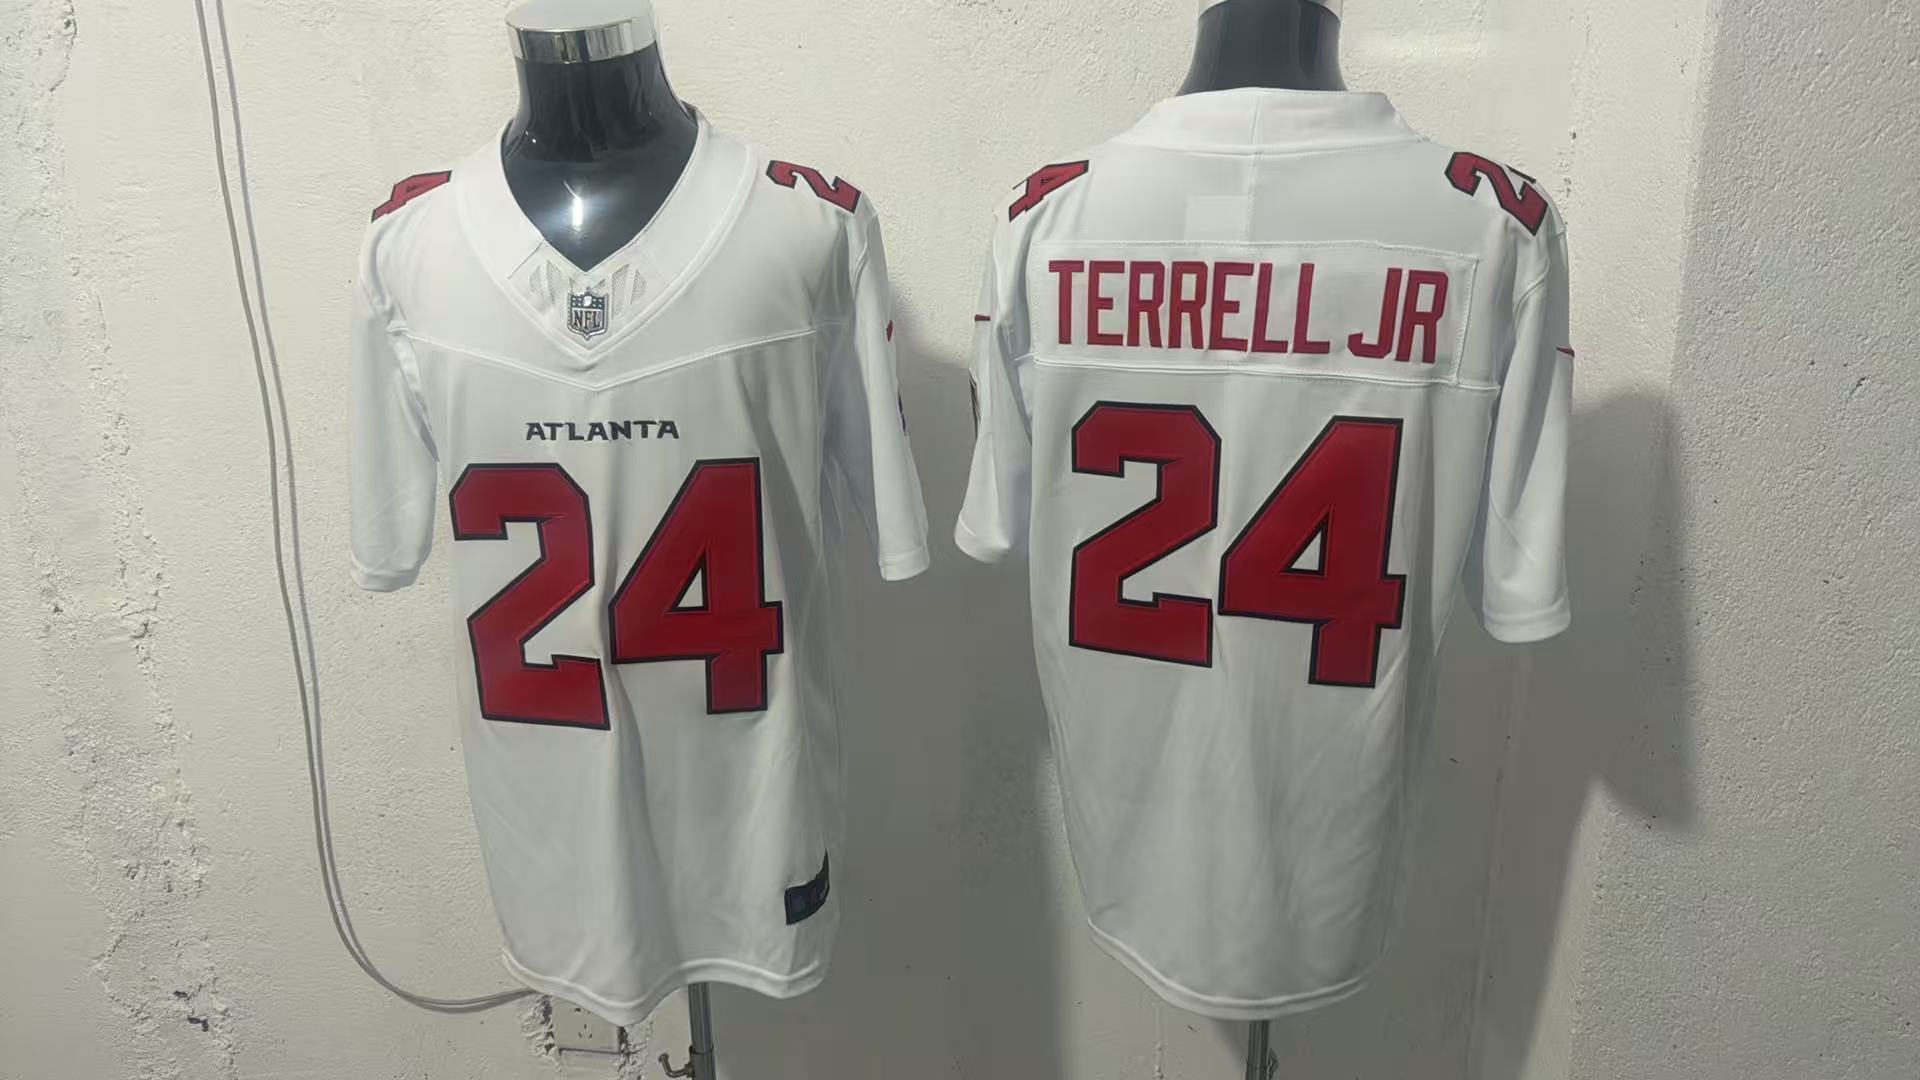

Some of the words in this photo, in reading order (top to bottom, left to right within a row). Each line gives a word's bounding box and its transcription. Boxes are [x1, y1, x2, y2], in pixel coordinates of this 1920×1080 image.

[371, 170, 452, 223] 4
[766, 160, 861, 214] 2
[573, 310, 601, 330] NFL
[1049, 260, 1331, 354] TERRELL
[1347, 268, 1449, 363] JR
[525, 420, 679, 441] ATLANTA
[1070, 401, 1408, 687] 24
[449, 457, 783, 730] 24
